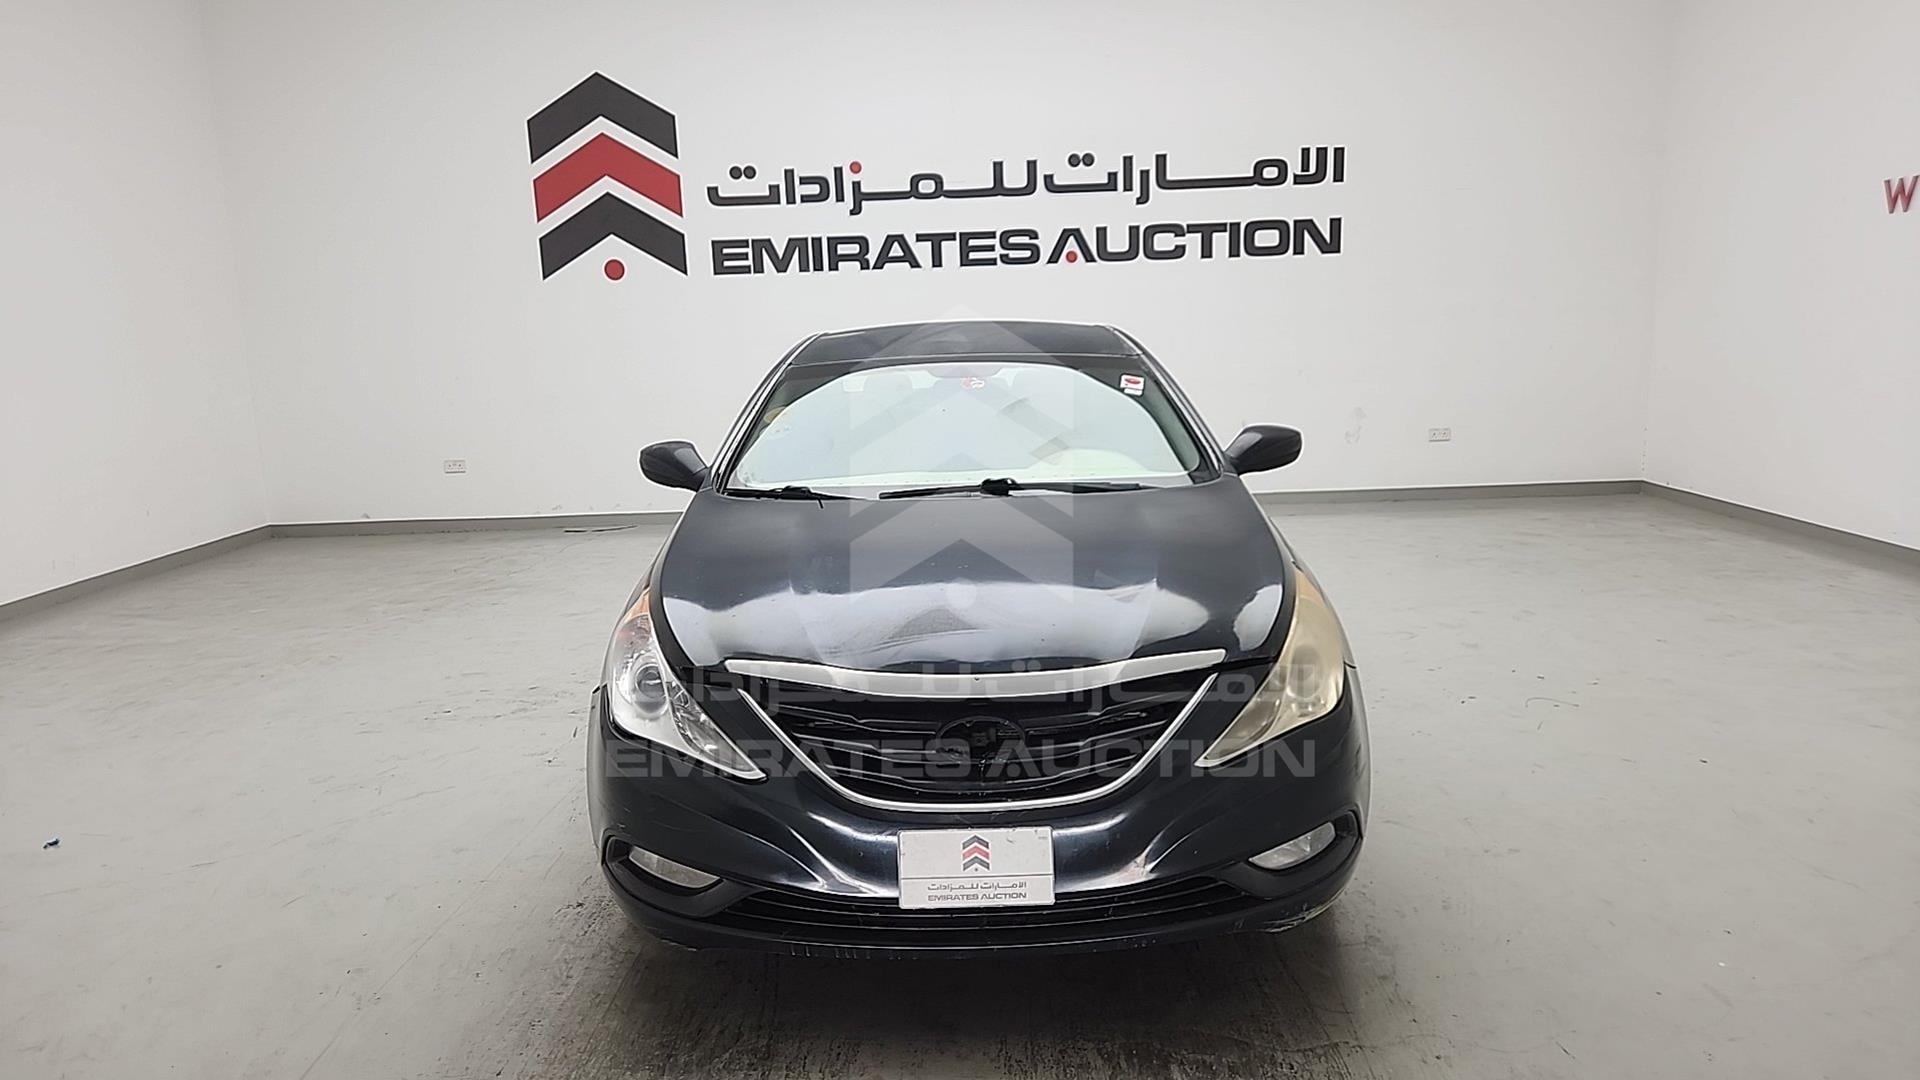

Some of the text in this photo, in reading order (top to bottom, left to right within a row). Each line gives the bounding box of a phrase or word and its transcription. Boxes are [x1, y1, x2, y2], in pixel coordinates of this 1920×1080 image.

[706, 147, 1346, 217] الامارات للمزادات
[711, 217, 1343, 276] EMIRATES AUCTION
[928, 892, 1027, 902] EMIRATES AUCTION
